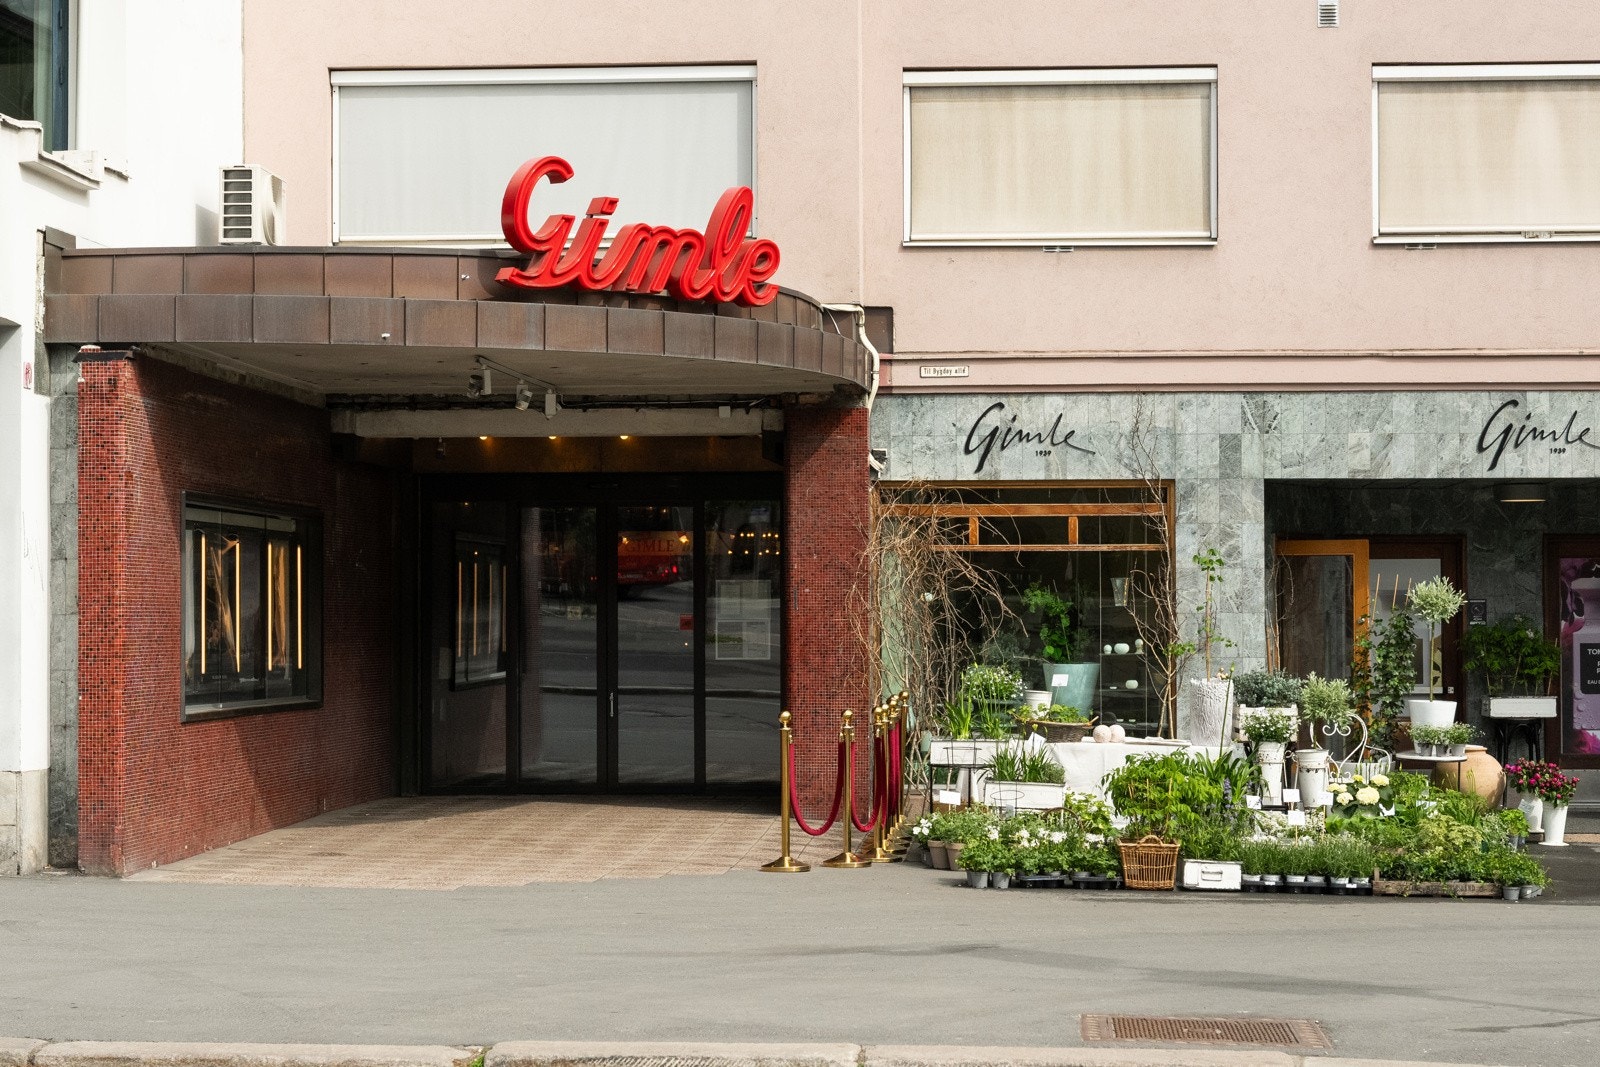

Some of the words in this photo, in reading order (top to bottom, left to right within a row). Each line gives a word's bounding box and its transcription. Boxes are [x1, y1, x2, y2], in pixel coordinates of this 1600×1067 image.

[495, 156, 780, 307] Gimle
[964, 402, 1096, 474] Gimle
[1476, 399, 1600, 472] Gimle
[1548, 447, 1567, 455] 1939
